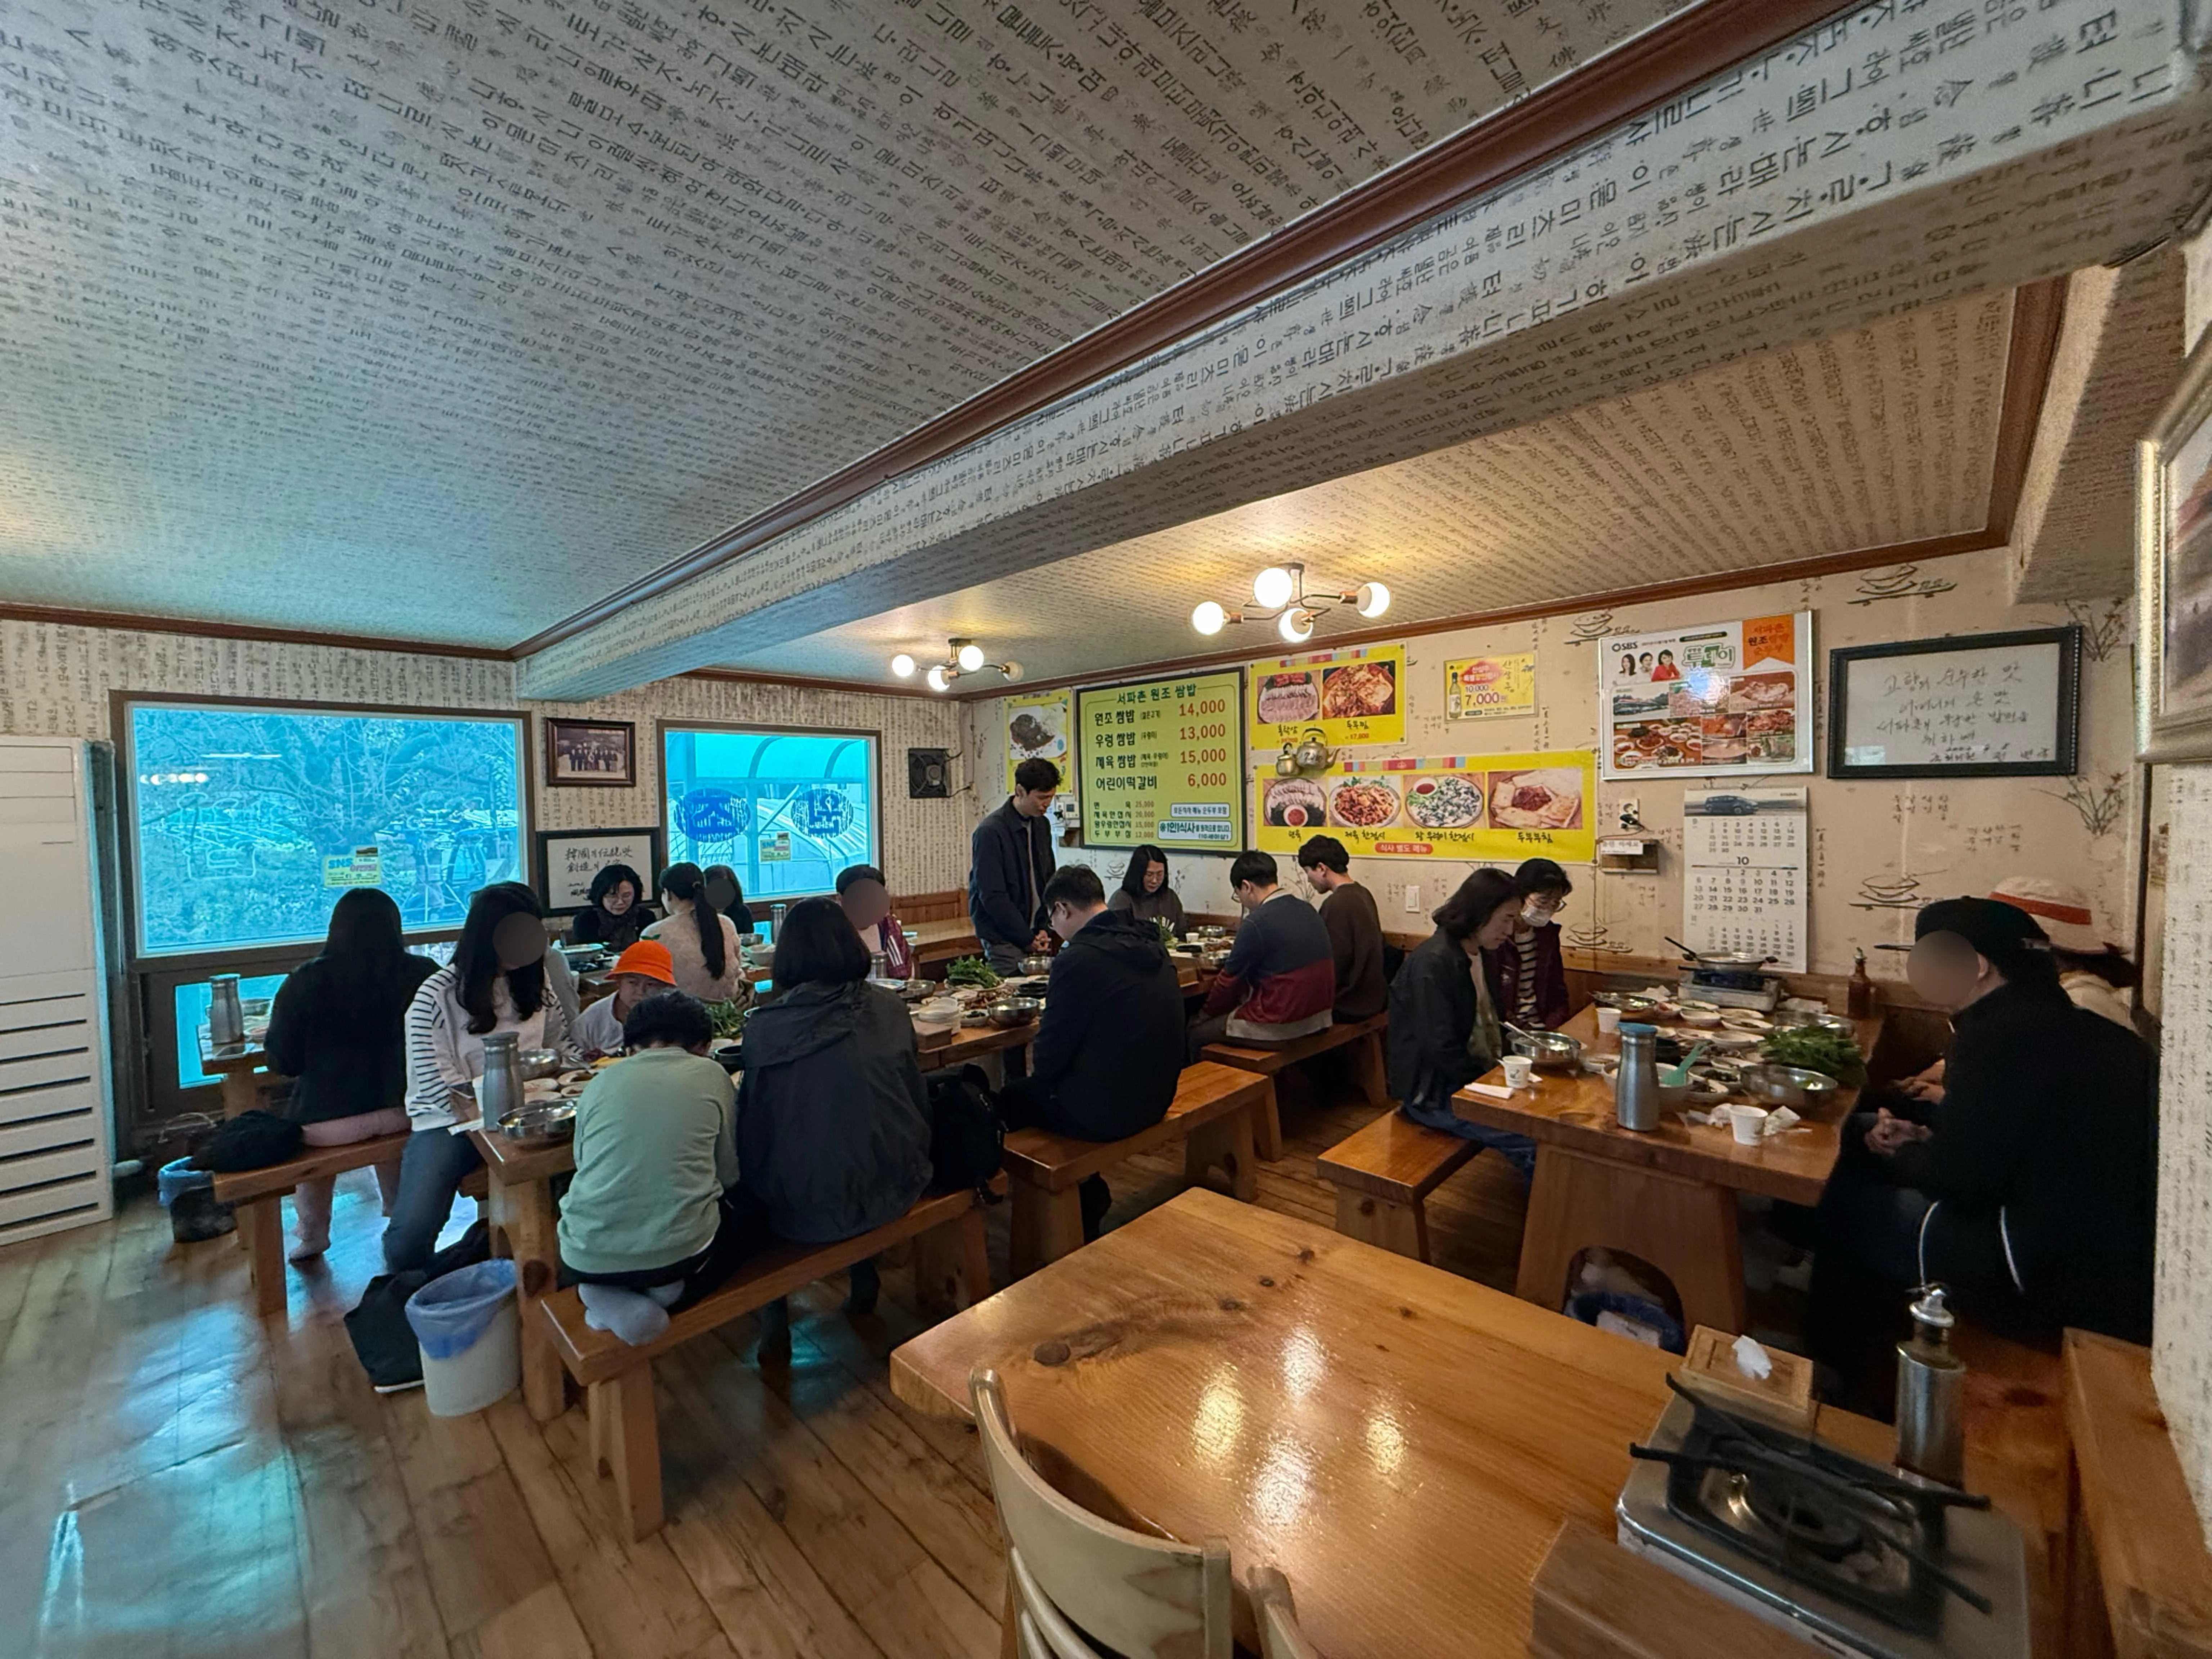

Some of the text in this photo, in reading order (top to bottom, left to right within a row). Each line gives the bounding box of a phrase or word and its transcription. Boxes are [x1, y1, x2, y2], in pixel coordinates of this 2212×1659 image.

[1621, 641, 1638, 650] SBS
[1117, 683, 1196, 705] 서파촌 원조 쌈밥
[1095, 712, 1113, 726] 원조
[1116, 709, 1135, 724] 쌈밥
[1179, 698, 1225, 717] 14,000
[1096, 733, 1114, 748] 우렁
[1117, 732, 1136, 746] 쌈밥
[1180, 723, 1226, 741] 13,000
[1096, 756, 1114, 769] 제육
[1118, 754, 1136, 768] 쌈밥
[1180, 748, 1226, 764] 15,000
[1096, 773, 1226, 791] 어린이떡갈비 6,000
[1517, 832, 1553, 843] 두부부침
[1737, 856, 1749, 865] 10
